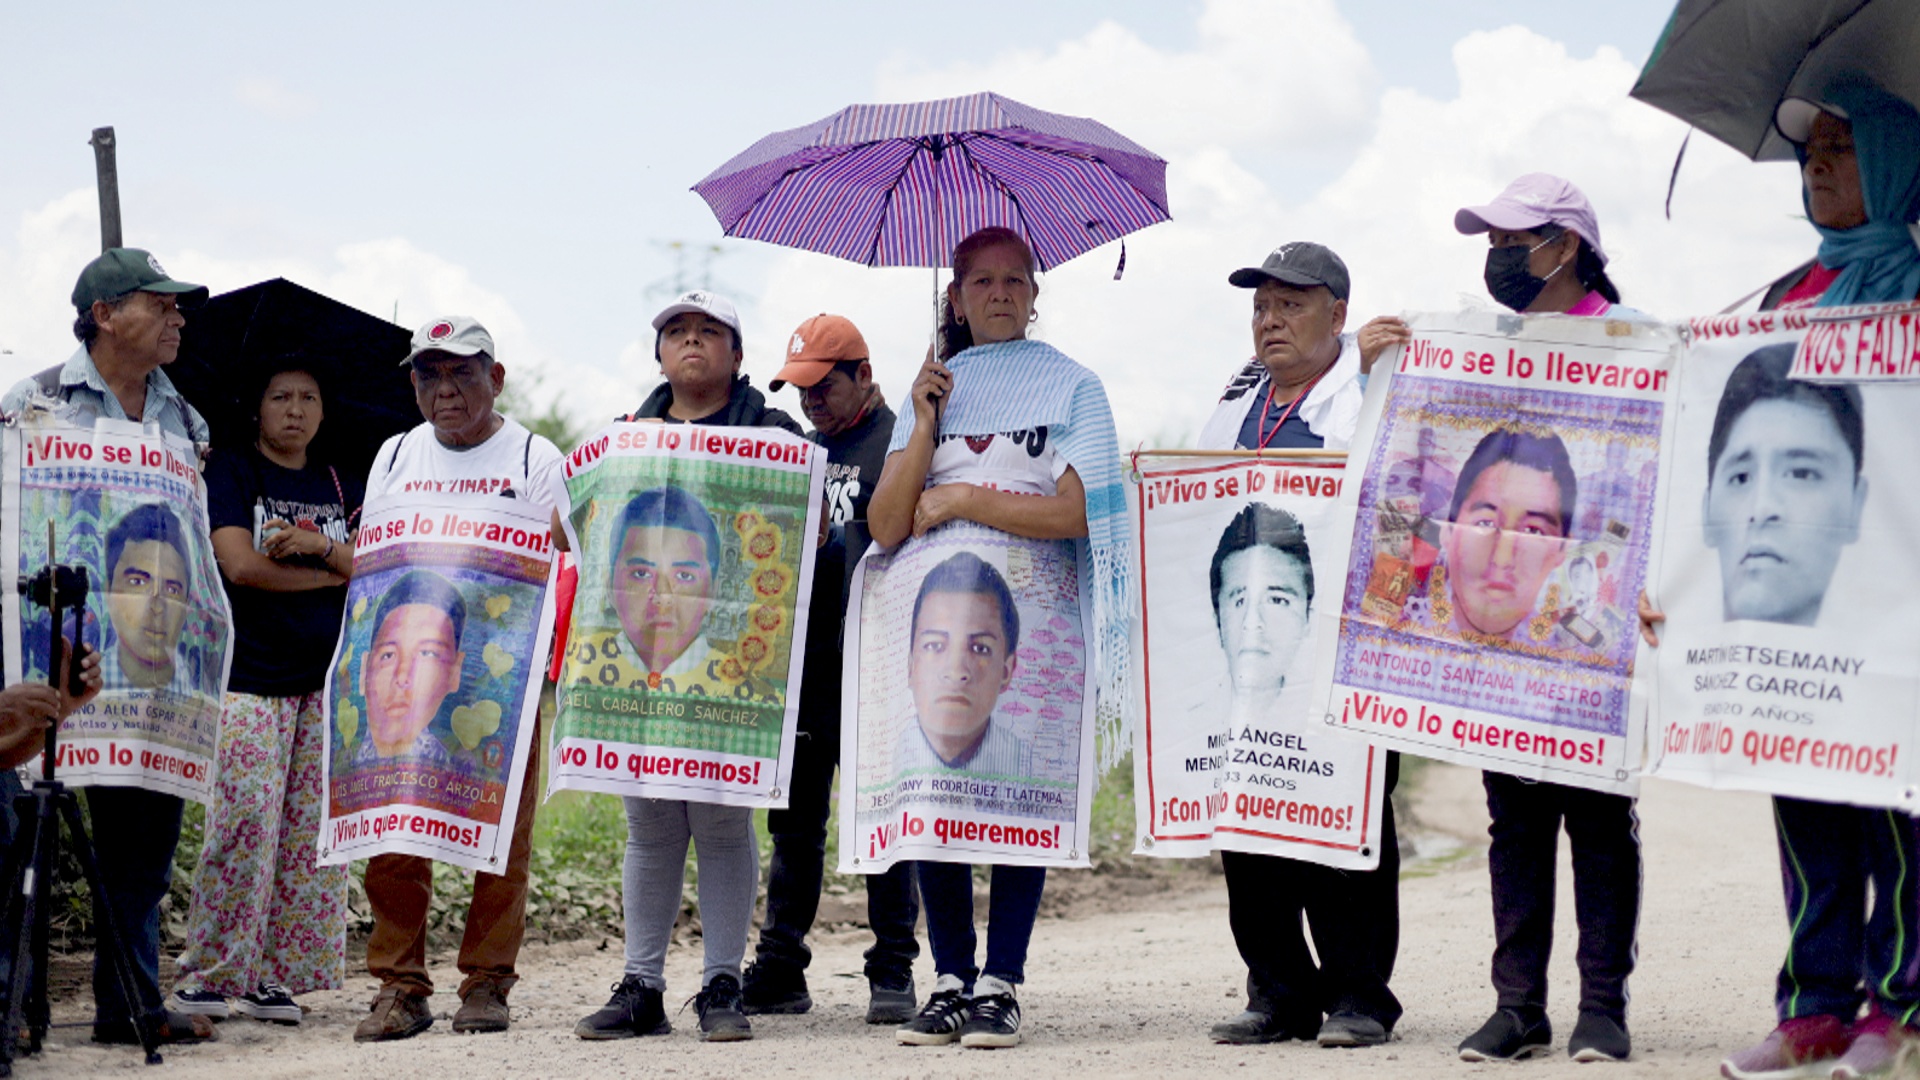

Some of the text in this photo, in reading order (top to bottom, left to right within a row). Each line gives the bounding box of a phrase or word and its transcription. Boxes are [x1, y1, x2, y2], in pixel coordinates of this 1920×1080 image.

[1400, 339, 1454, 373] ¡Vivo
[1462, 351, 1495, 375] se
[1507, 348, 1534, 378] lo
[1796, 322, 1850, 375] NOS
[27, 435, 93, 467] ¡Vivo
[102, 445, 132, 464] se
[140, 444, 162, 467] lo
[566, 435, 610, 478] ¡Vivo
[617, 431, 648, 450] se
[657, 429, 681, 450] lo
[690, 429, 809, 466] llevaron!
[1148, 478, 1207, 510] ¡Vivo
[1214, 476, 1239, 498] se
[1246, 470, 1266, 495] lo
[386, 520, 405, 539] se
[412, 512, 434, 535] lo
[441, 514, 551, 554] llevaron!
[1358, 650, 1603, 708] ANTONIO SANTANA MAESTRO
[1746, 672, 1843, 702] GARCÍA
[602, 697, 685, 718] CABALLERO
[695, 703, 759, 727] SÁNCHEZ
[1342, 692, 1606, 766] ¡Vivo lo queremos!
[1751, 704, 1815, 726] AÑOS
[109, 741, 133, 767] lo
[1238, 723, 1308, 751] ÁNGEL
[1743, 729, 1899, 778] queremos!
[596, 743, 619, 770] lo
[627, 752, 761, 785] queremos!
[1232, 748, 1335, 777] ZACARIAS
[445, 780, 498, 805] ARZOLA
[1006, 786, 1063, 805] TLATEMPA
[1247, 773, 1298, 792] AÑOS
[902, 811, 925, 837] lo
[934, 817, 1060, 848] queremos!
[1161, 796, 1201, 827] ¡Con
[1235, 792, 1354, 832] queremos!
[332, 813, 482, 850] ¡Vivo lo queremos!
